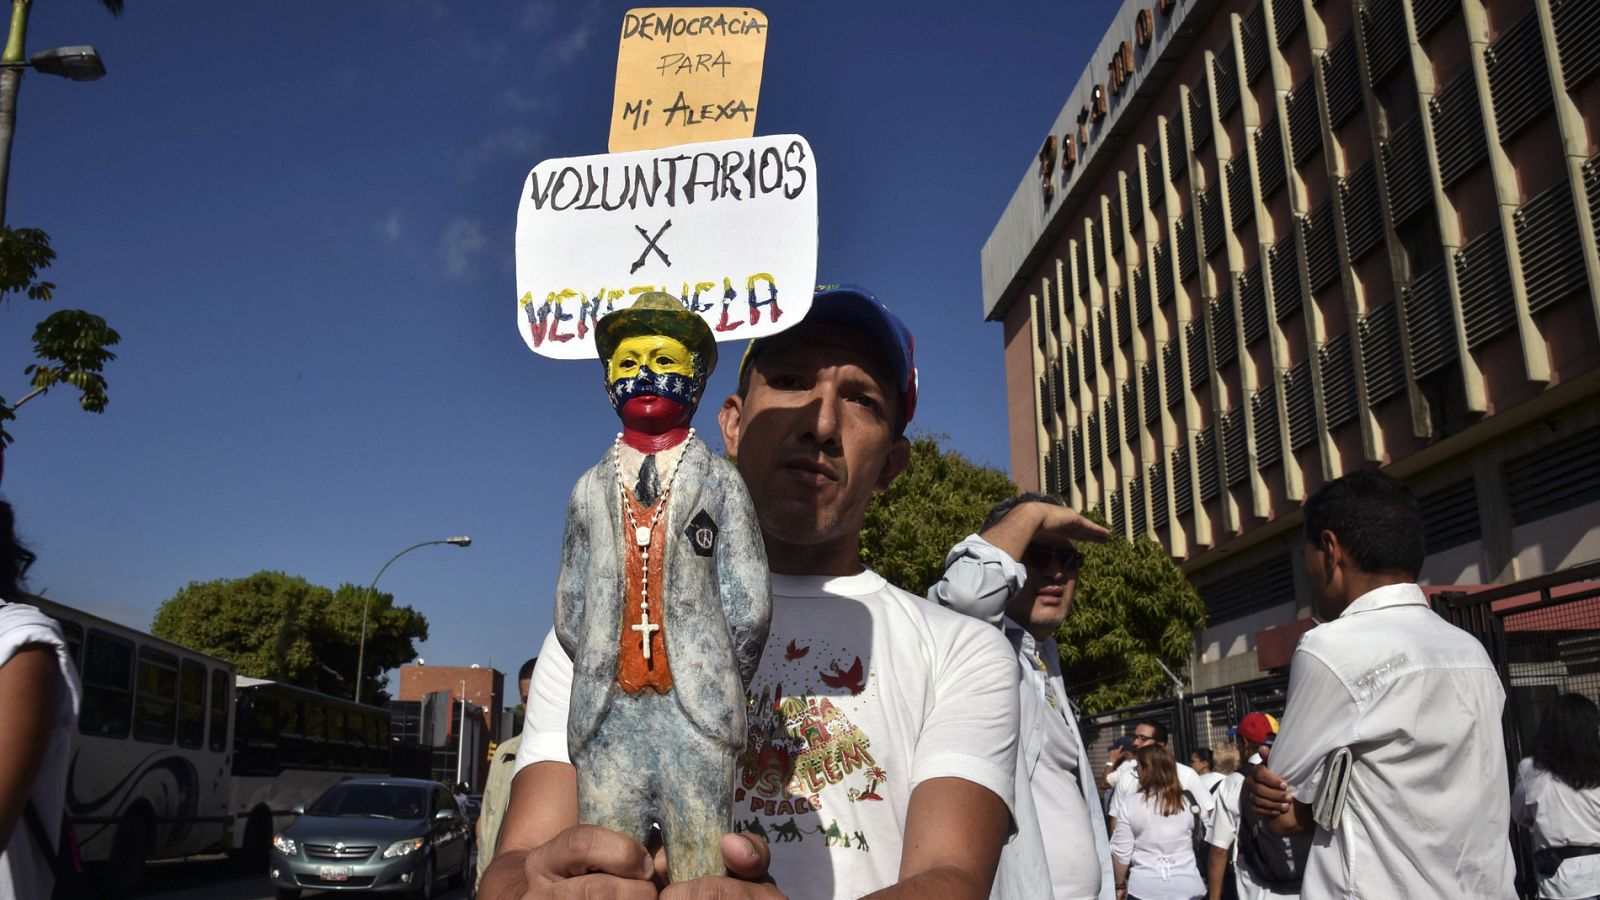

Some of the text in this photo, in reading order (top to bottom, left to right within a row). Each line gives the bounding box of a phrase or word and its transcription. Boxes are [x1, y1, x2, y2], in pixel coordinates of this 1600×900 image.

[656, 50, 732, 78] PARA
[662, 91, 755, 127] ALEXA
[530, 140, 806, 212] VOLUNTARIOS
[750, 793, 823, 816] PEACE
